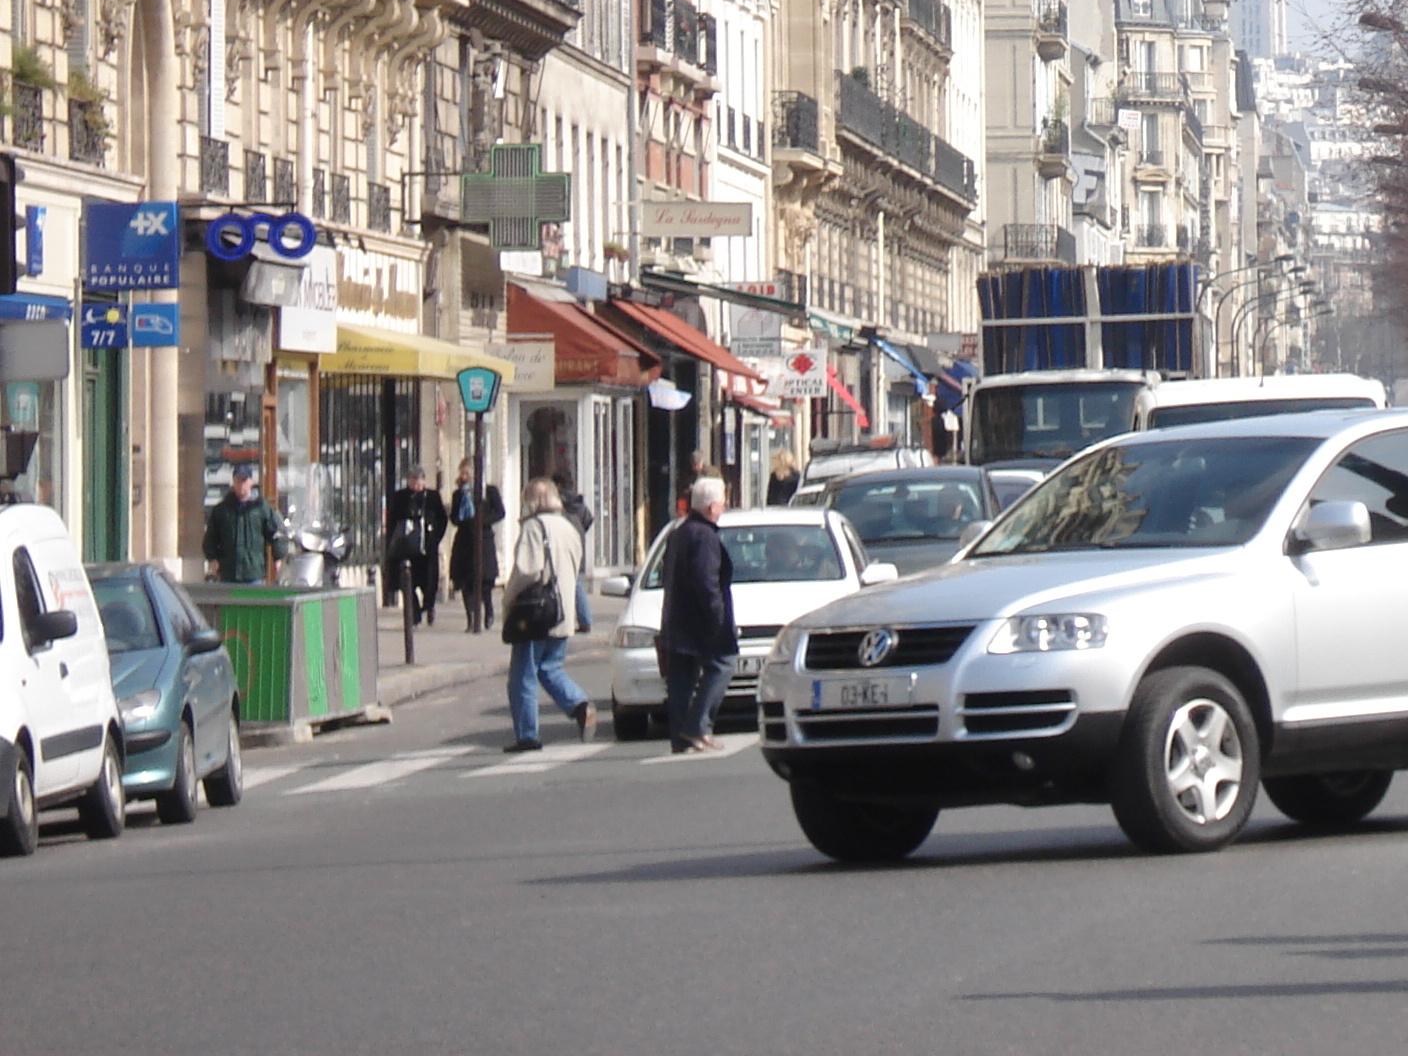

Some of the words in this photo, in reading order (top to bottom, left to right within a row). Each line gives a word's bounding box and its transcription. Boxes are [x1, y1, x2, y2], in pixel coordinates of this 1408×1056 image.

[91, 263, 170, 274] BANQUE
[91, 275, 170, 285] POPULAIRE
[91, 330, 116, 345] 7/7
